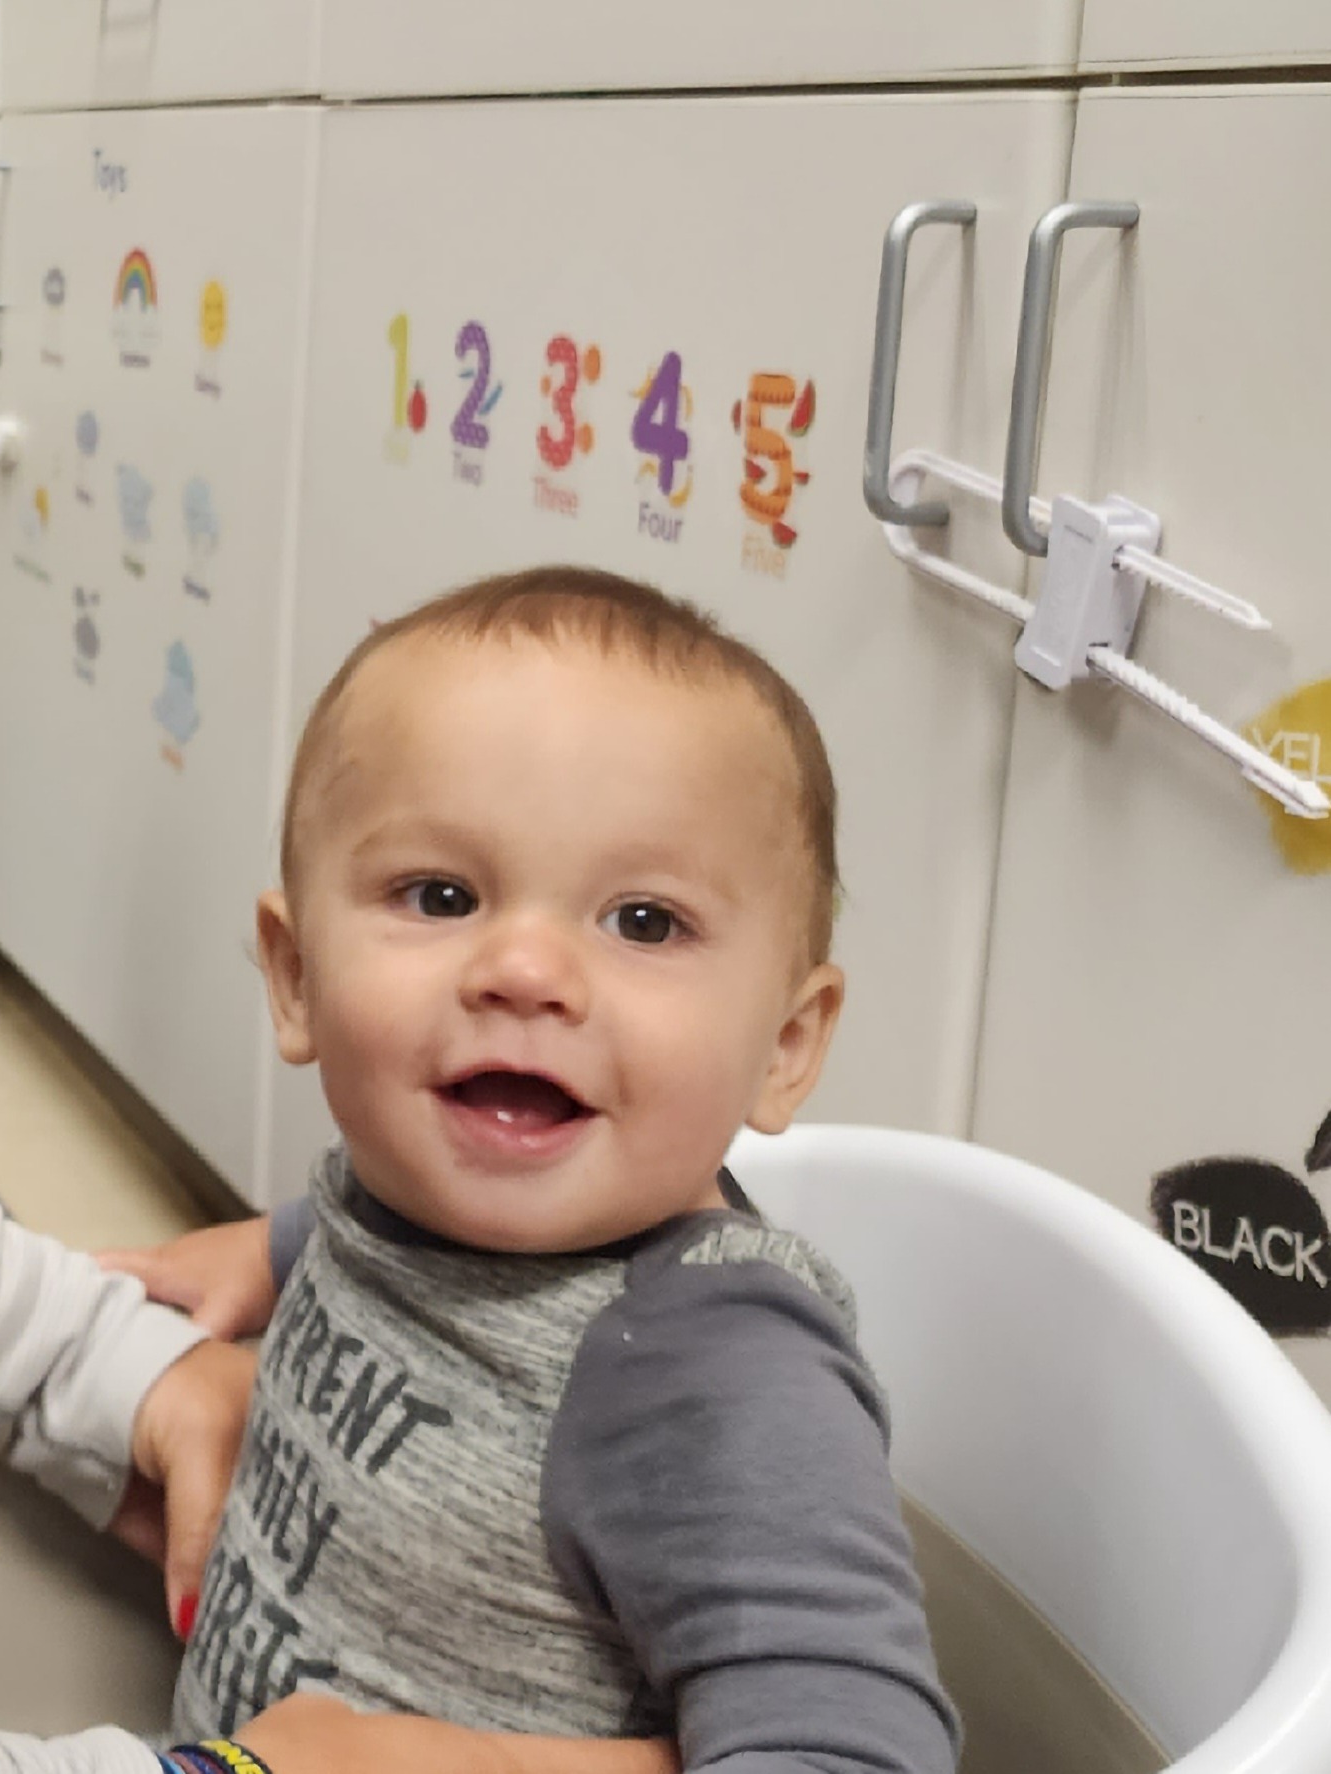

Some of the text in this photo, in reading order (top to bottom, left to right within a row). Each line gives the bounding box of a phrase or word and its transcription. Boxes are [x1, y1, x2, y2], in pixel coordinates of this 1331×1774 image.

[388, 312, 796, 526] 1 2 3 4 5
[638, 501, 684, 544] Four
[1172, 1200, 1328, 1289] BLACK
[265, 1272, 454, 1477] RRENT
